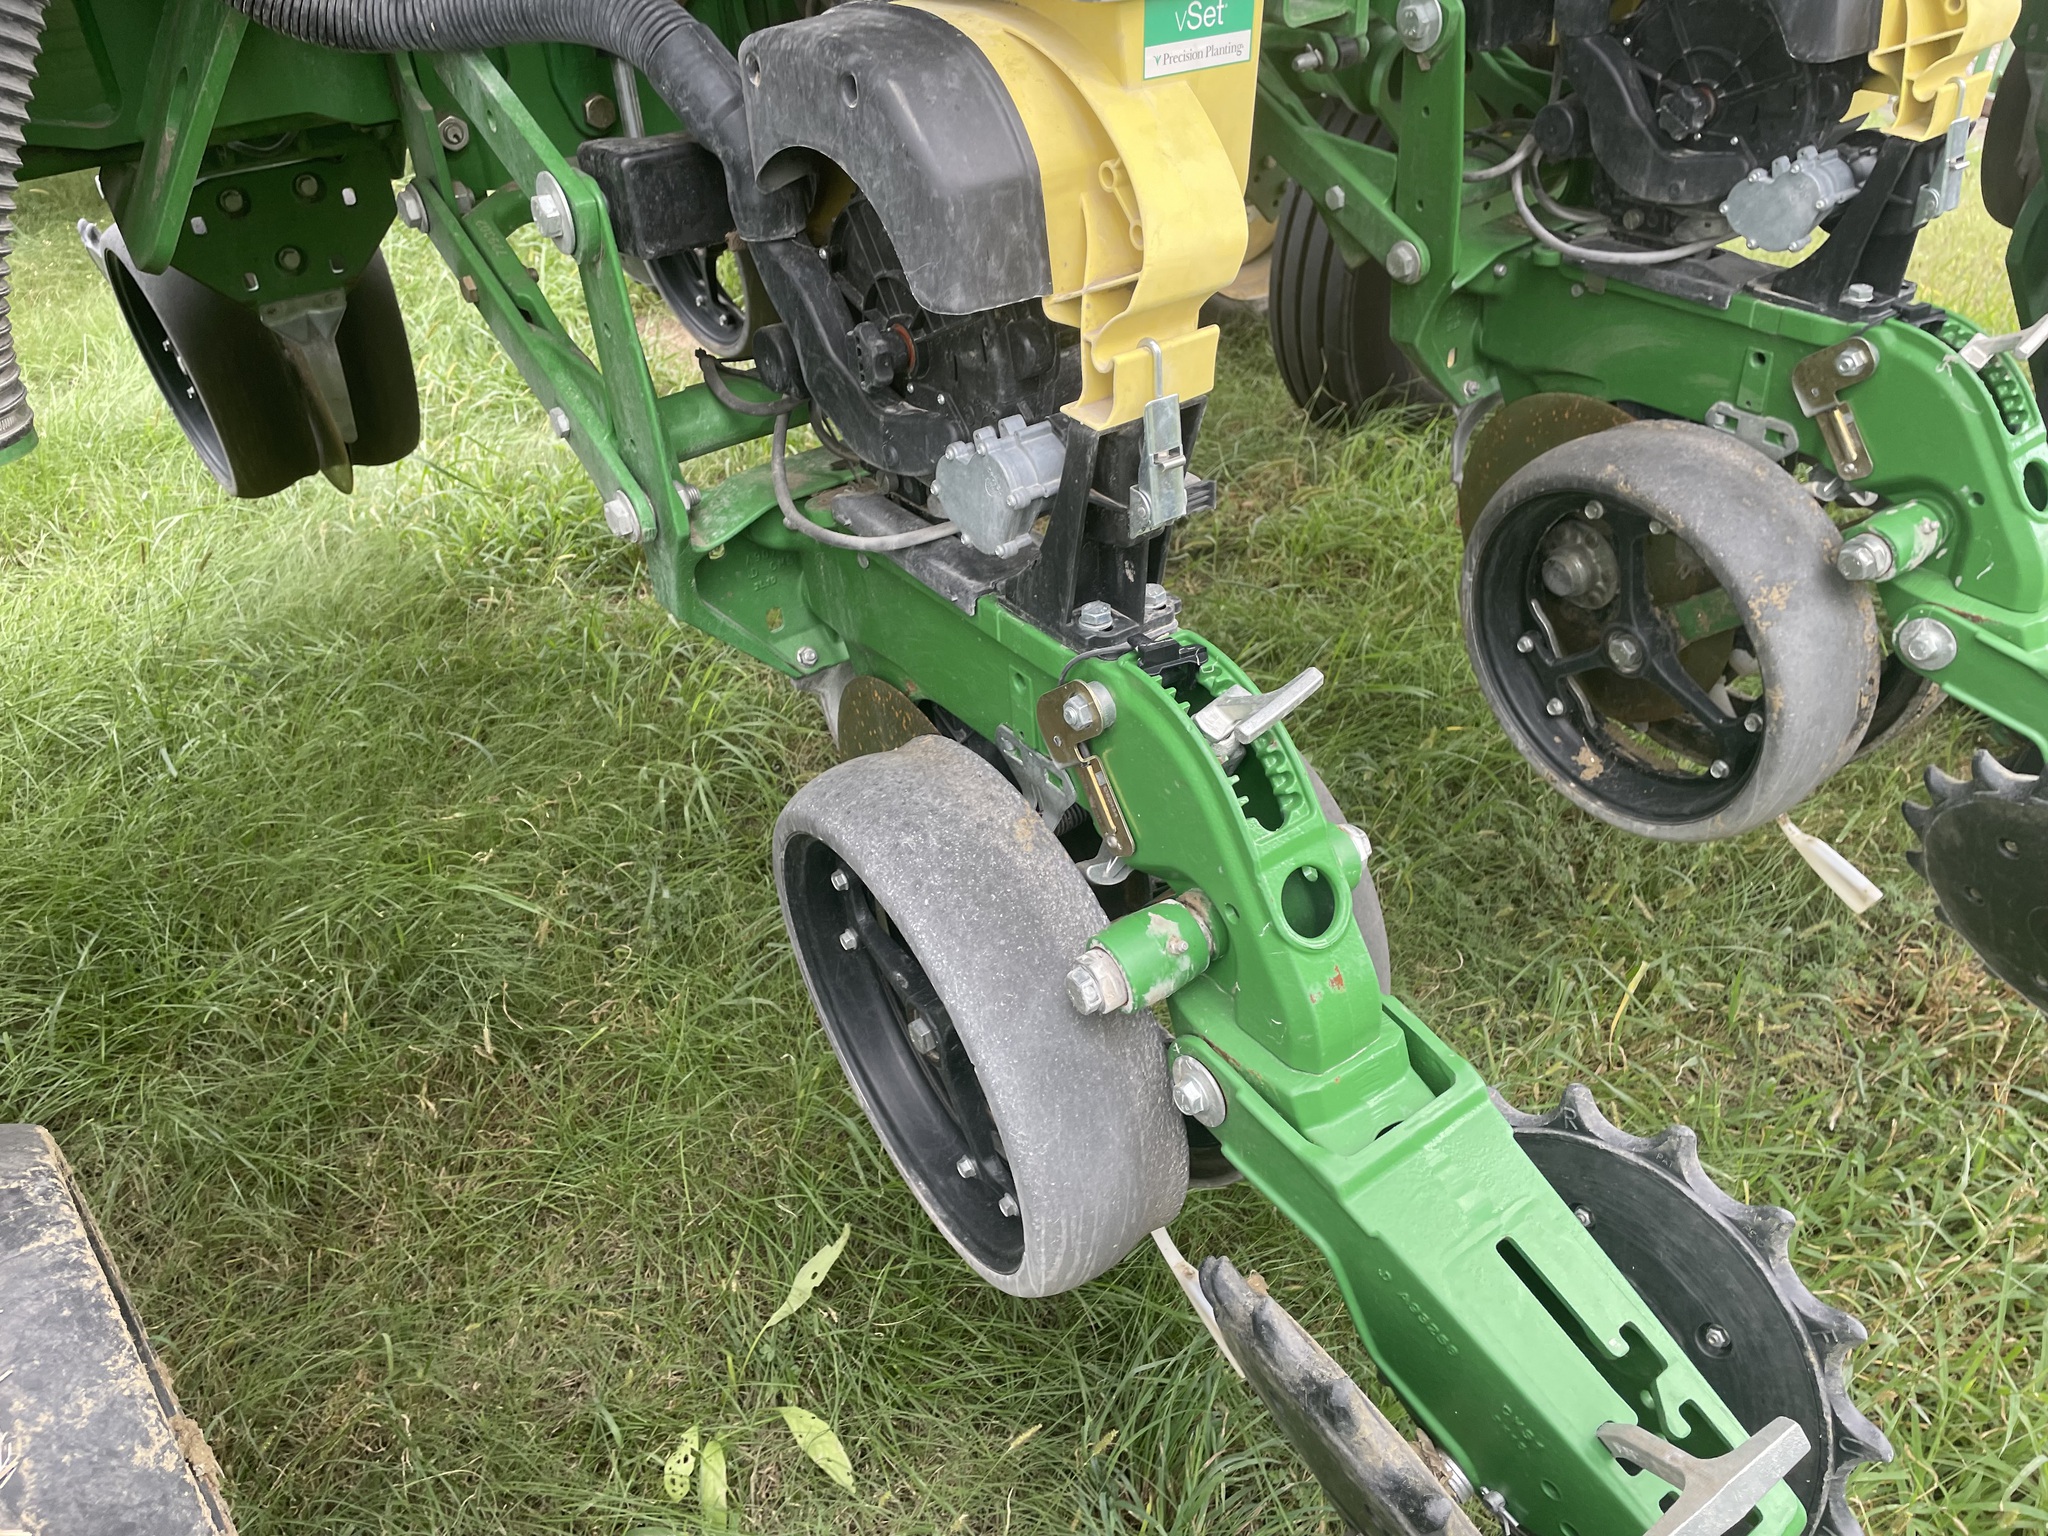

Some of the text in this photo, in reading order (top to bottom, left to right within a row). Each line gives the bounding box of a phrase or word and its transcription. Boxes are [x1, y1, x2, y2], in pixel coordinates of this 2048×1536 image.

[1175, 0, 1225, 32] vSet
[1163, 42, 1242, 65] Precision Planting
[1563, 1106, 1579, 1131] R
